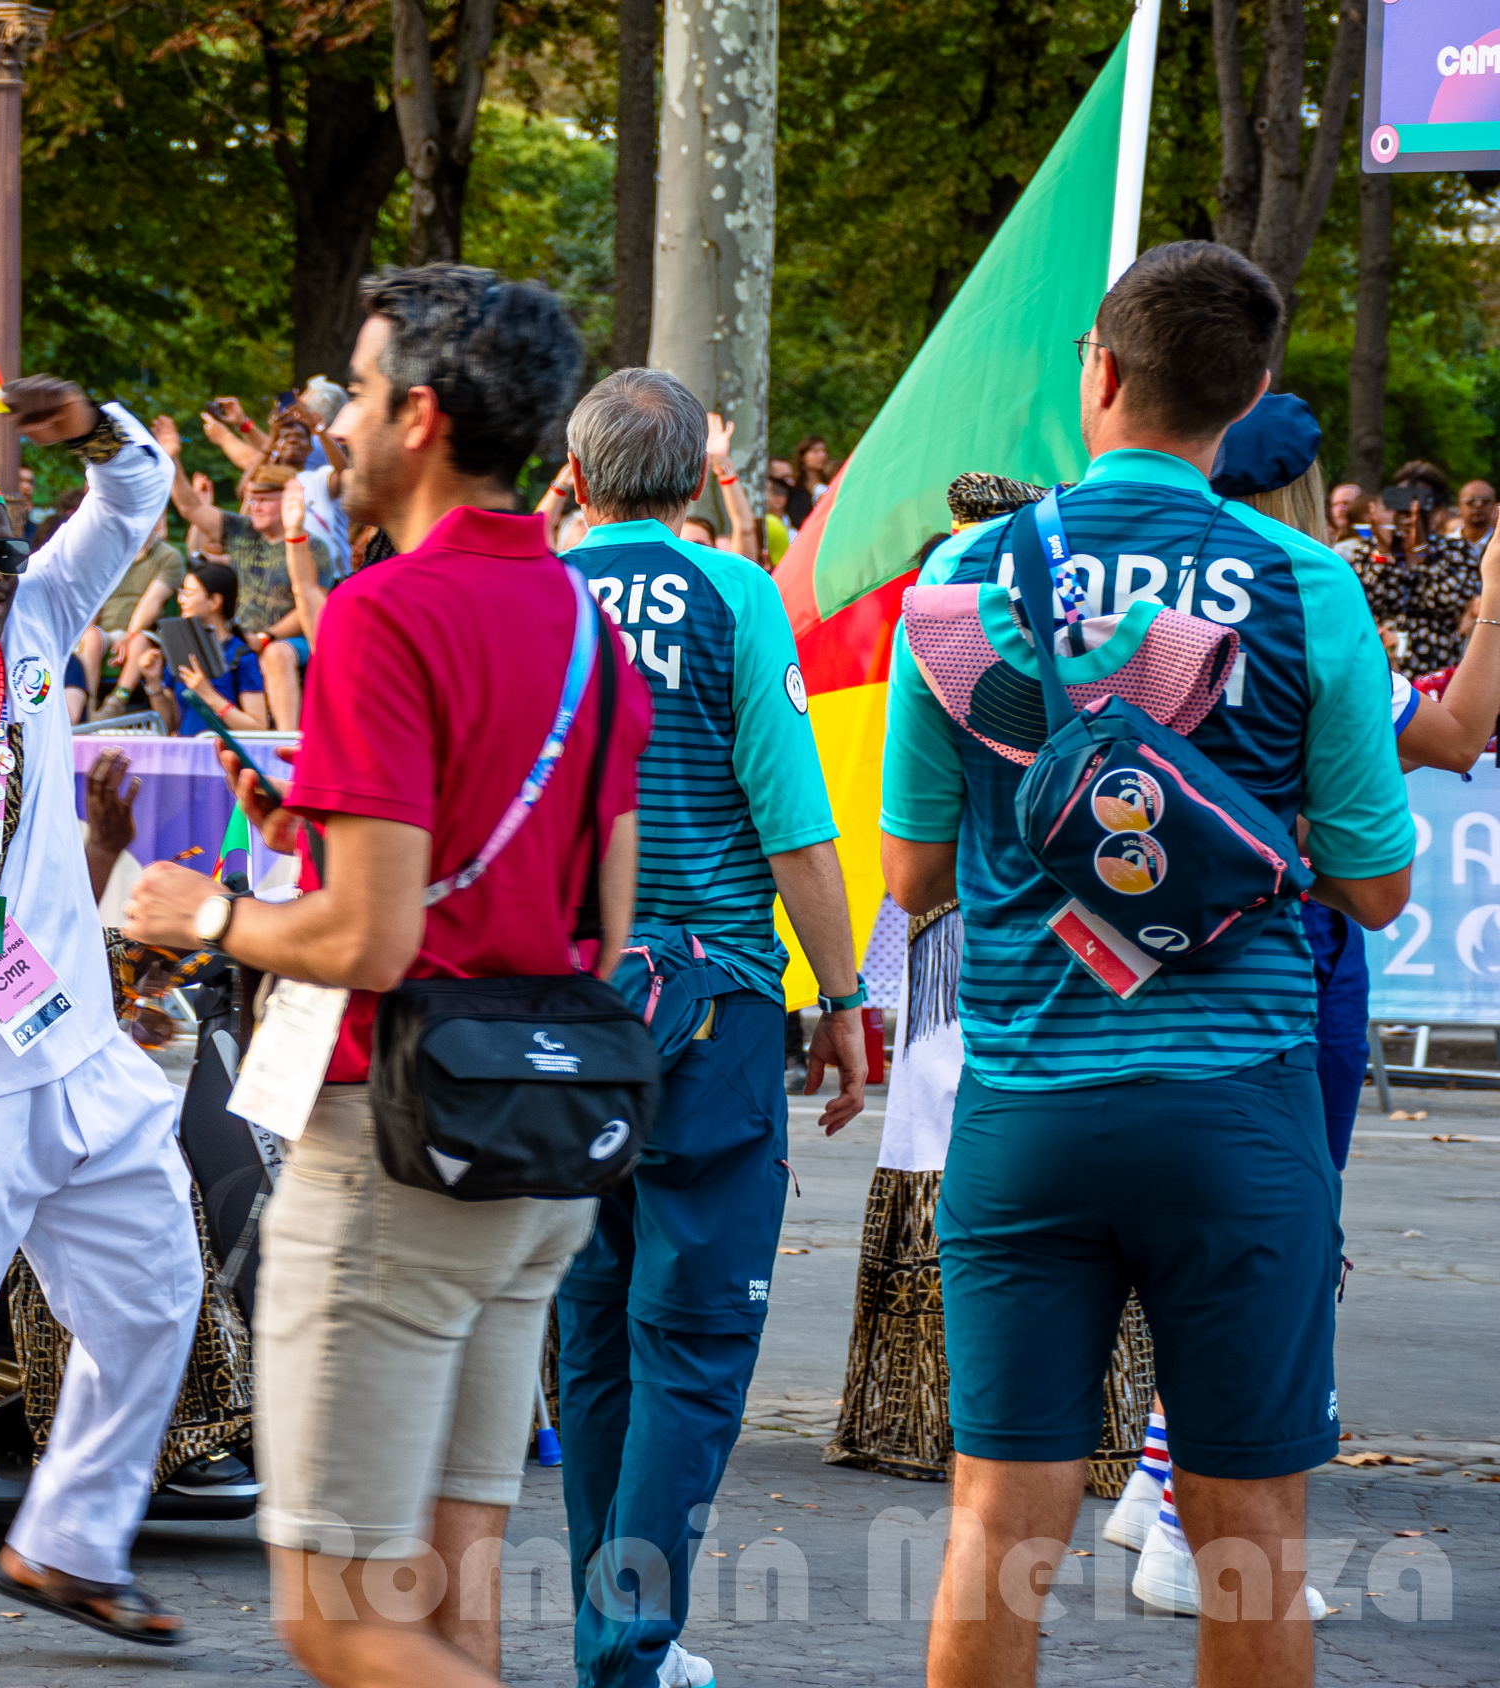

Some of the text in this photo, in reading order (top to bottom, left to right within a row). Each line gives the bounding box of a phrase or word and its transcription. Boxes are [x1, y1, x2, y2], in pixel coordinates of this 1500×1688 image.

[6, 937, 25, 954] PASS
[24, 1024, 36, 1037] 2
[56, 997, 69, 1010] R
